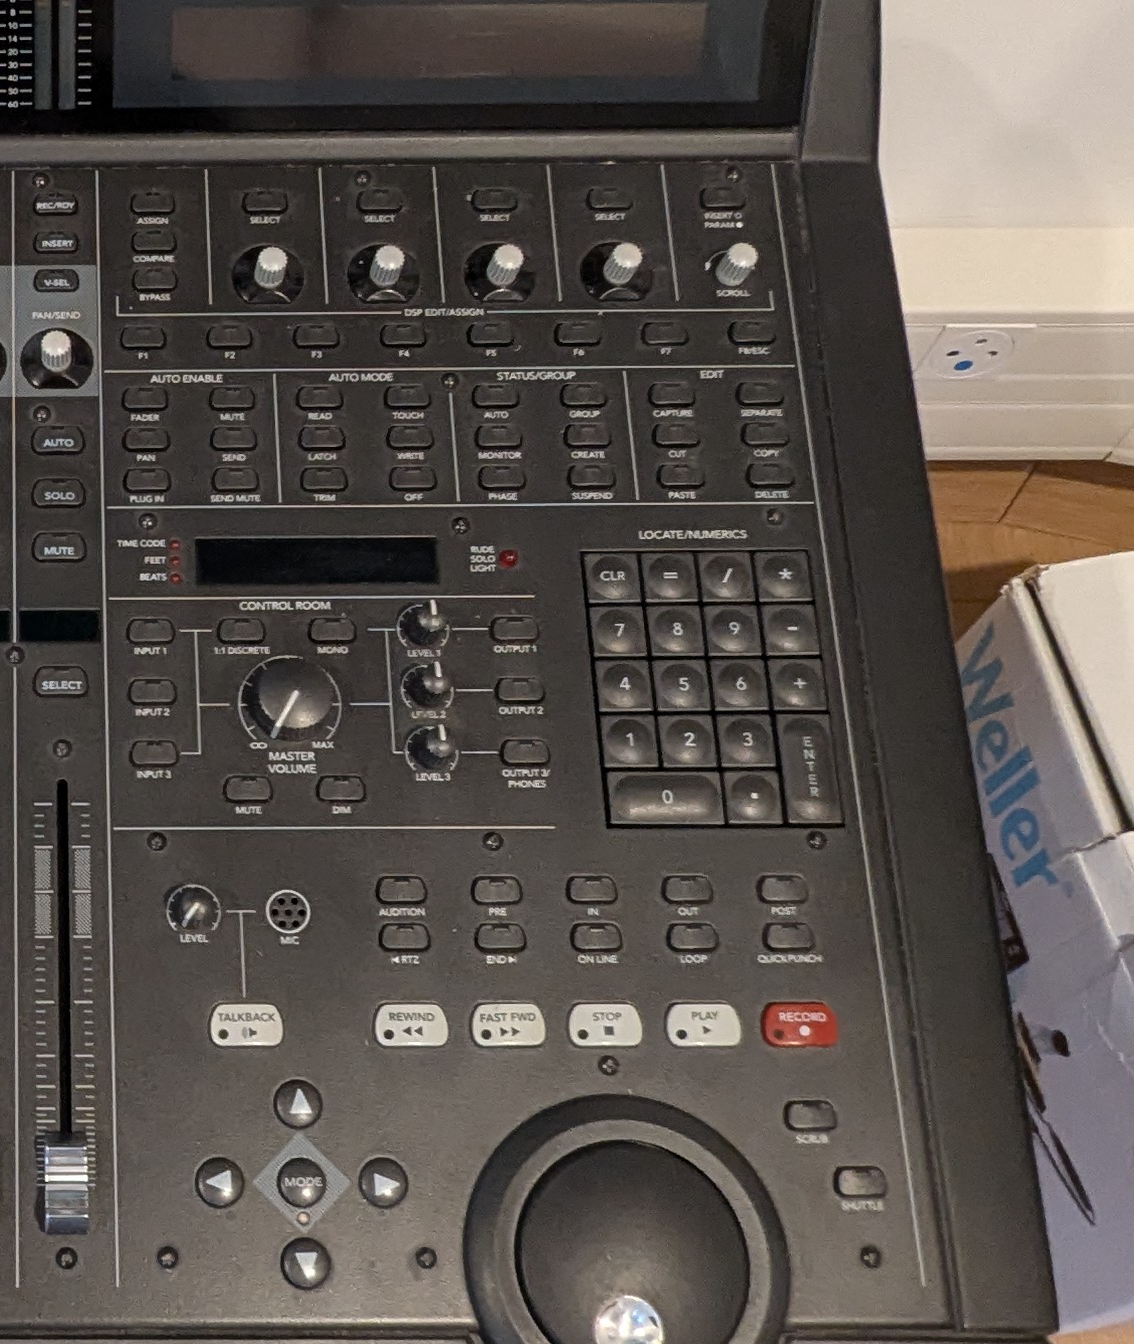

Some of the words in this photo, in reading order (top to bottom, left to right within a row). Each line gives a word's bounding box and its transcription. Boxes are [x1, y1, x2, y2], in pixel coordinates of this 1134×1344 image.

[404, 309, 423, 317] DSP
[424, 307, 484, 317] EDIT/ASSIGN
[151, 374, 180, 383] AUTO
[182, 374, 223, 383] ENABLE
[329, 373, 359, 382] AUTO
[361, 373, 393, 381] MODE
[497, 372, 576, 381] STATUS/GROUP
[700, 370, 724, 379] EDIT
[131, 414, 159, 422] FADER
[309, 412, 332, 420] READ
[393, 412, 424, 420] TOUCH
[484, 411, 508, 419] AUTO
[570, 410, 600, 418] GROUP
[44, 438, 74, 446] AUTO
[137, 454, 156, 462] PAN
[571, 451, 605, 459] CREATE
[44, 492, 75, 500] SOLO
[130, 495, 151, 503] PLUG
[154, 495, 164, 503] IN
[405, 493, 423, 501] OFF
[572, 492, 613, 500] SUSPEND
[669, 491, 696, 499] PASTE
[639, 529, 747, 540] LOCATE/NUMERICS
[117, 540, 137, 548] TIME
[140, 540, 165, 548] CODE
[44, 547, 74, 555] MUTE
[471, 546, 494, 554] RUDE
[145, 557, 166, 565] FEET
[470, 555, 495, 563] SOLO
[470, 564, 495, 572] LIGHT
[140, 573, 167, 582] BEATS
[600, 571, 625, 581] CLR
[240, 602, 295, 611] CONTROL
[297, 601, 331, 610] ROOM
[615, 624, 625, 636] 7
[673, 623, 683, 635] 8
[730, 622, 739, 634] 9
[134, 646, 160, 655] INPUT
[318, 646, 348, 654] MONO
[493, 644, 529, 653] OUTPUT
[42, 681, 82, 689] SELECT
[620, 678, 630, 690] 4
[679, 678, 689, 691] 5
[736, 678, 747, 689] 6
[135, 708, 162, 717] INPUT
[499, 706, 534, 715] OUTPUT
[626, 733, 634, 746] 1
[684, 733, 695, 747] 2
[743, 733, 753, 746] 3
[312, 741, 334, 749] MAX
[269, 751, 315, 762] MASTER
[960, 624, 1060, 889] Weller
[268, 763, 317, 774] VOLUME
[137, 770, 163, 778] INPUT
[662, 790, 673, 803] 0
[235, 806, 262, 814] MUTE
[332, 805, 351, 814] DIM
[379, 908, 425, 916] AUDITION
[588, 908, 599, 916] IN
[678, 907, 698, 915] OUT
[771, 907, 796, 915] POST
[180, 934, 208, 943] LEVEL
[280, 936, 299, 944] MIC
[402, 956, 419, 964] RTZ
[578, 955, 593, 964] ON
[596, 955, 618, 963] LINE
[680, 955, 707, 964] LOOP
[218, 1013, 275, 1022] TALKBACK
[388, 1013, 435, 1022] REWIND
[480, 1013, 506, 1022] FAST
[511, 1012, 536, 1021] FWD
[592, 1012, 621, 1021] STOP
[692, 1011, 718, 1020] PLAY
[779, 1012, 825, 1021] RECORD
[285, 1176, 323, 1186] MODE
